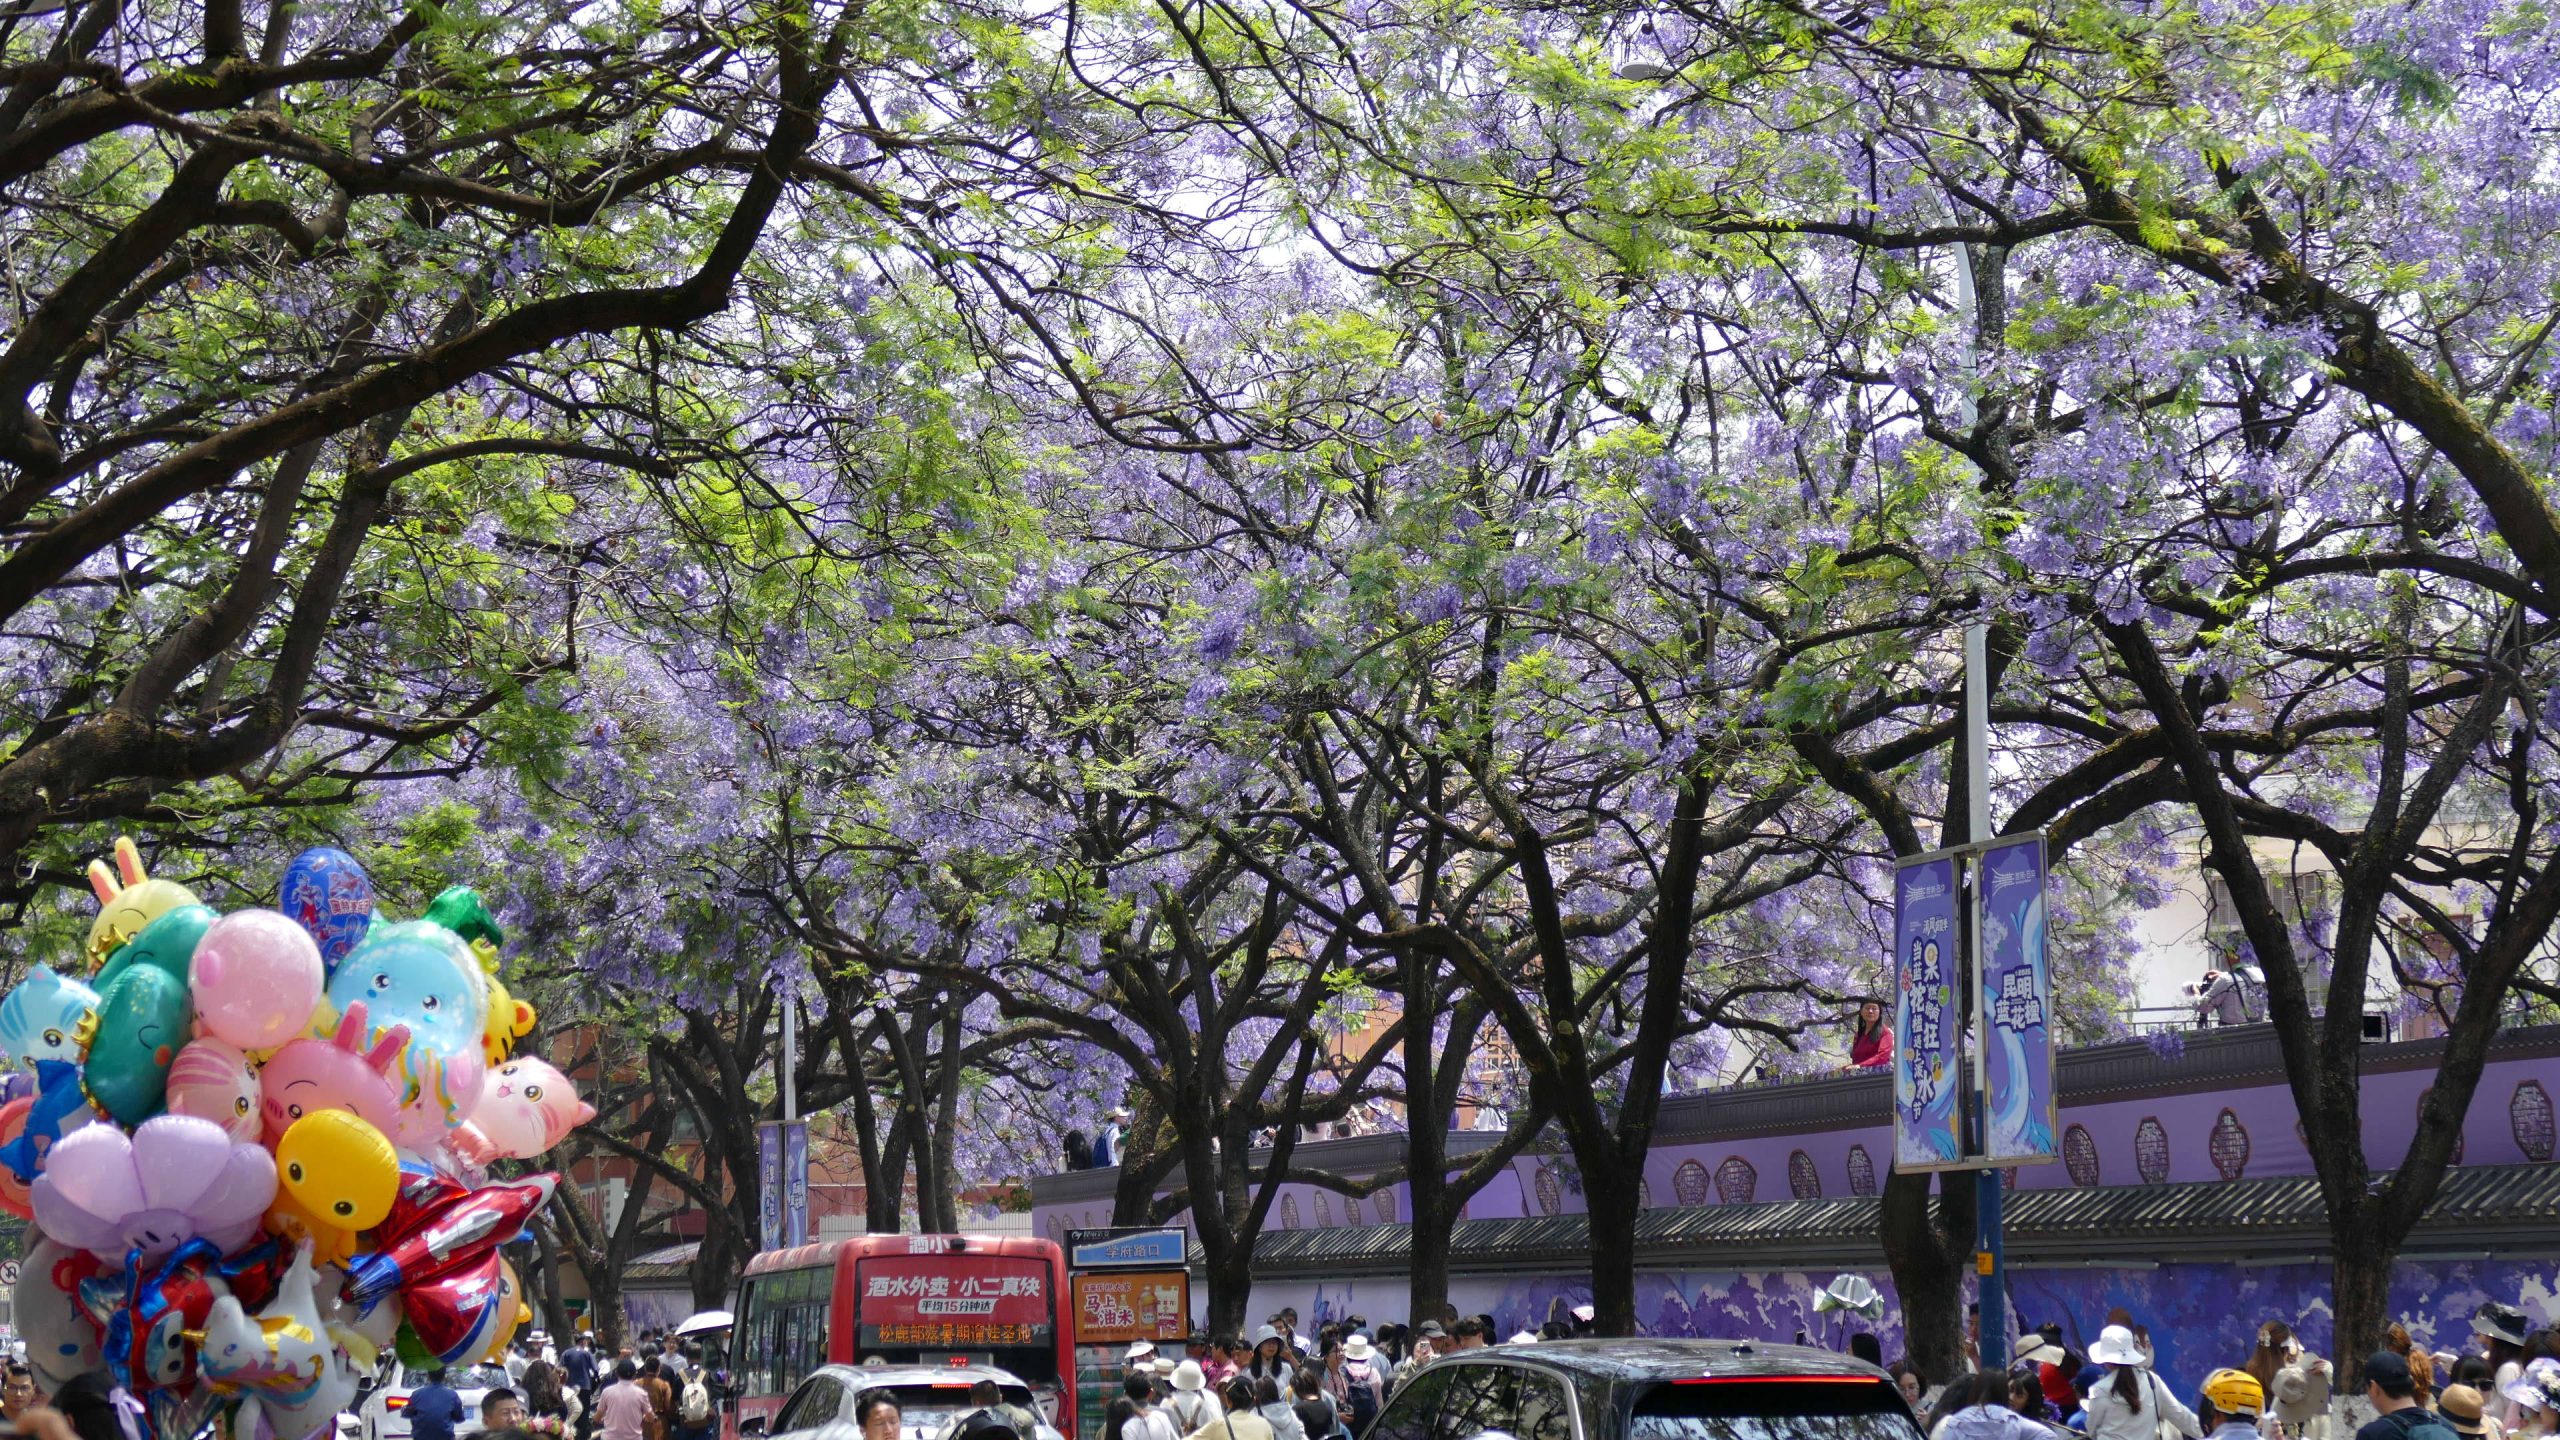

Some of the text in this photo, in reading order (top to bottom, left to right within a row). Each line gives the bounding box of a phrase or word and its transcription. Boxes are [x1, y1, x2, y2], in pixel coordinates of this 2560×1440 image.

[2003, 974, 2033, 999] 昆明
[1995, 1000, 2041, 1029] 蓝花楹
[1106, 1244, 1160, 1257] 学府路口
[921, 1300, 992, 1313] 平均15分钟达
[1084, 1294, 1116, 1314] 马上
[1099, 1308, 1135, 1328] 油米
